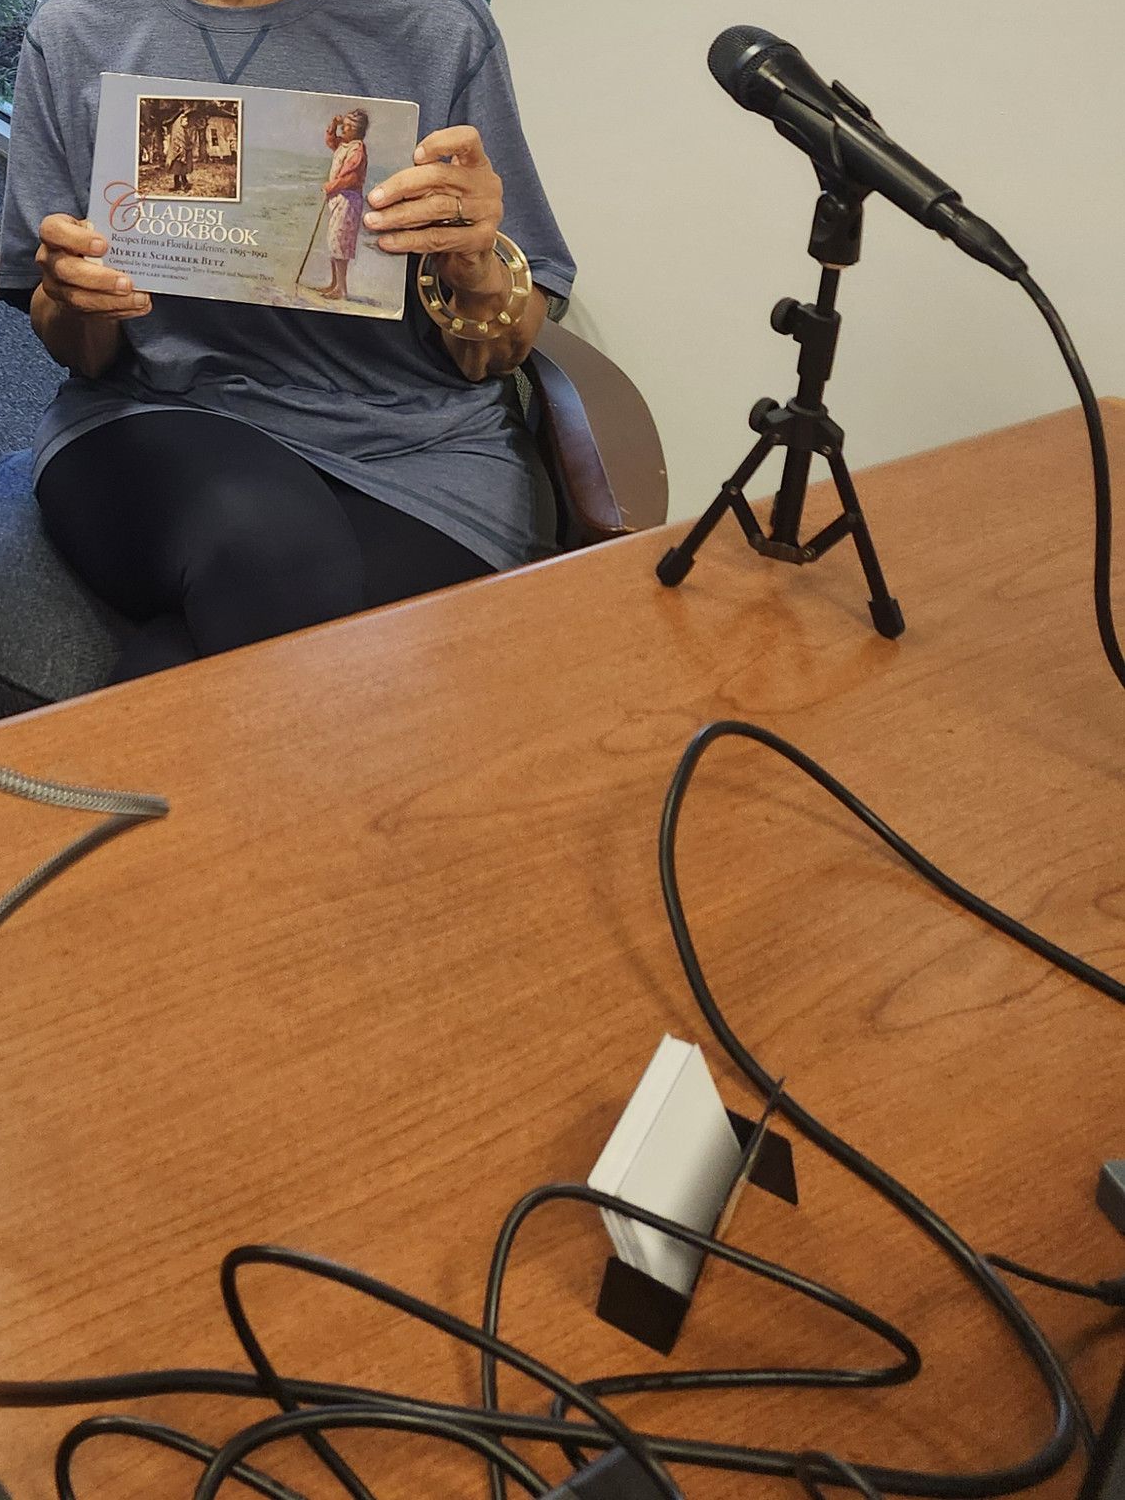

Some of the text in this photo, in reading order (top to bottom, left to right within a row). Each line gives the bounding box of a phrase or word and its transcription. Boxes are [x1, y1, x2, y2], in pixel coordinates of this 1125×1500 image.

[104, 180, 225, 232] CALADESI
[111, 233, 140, 246] Recipes
[141, 235, 159, 246] from
[166, 239, 193, 250] Florida
[135, 217, 259, 246] COOKBOOK
